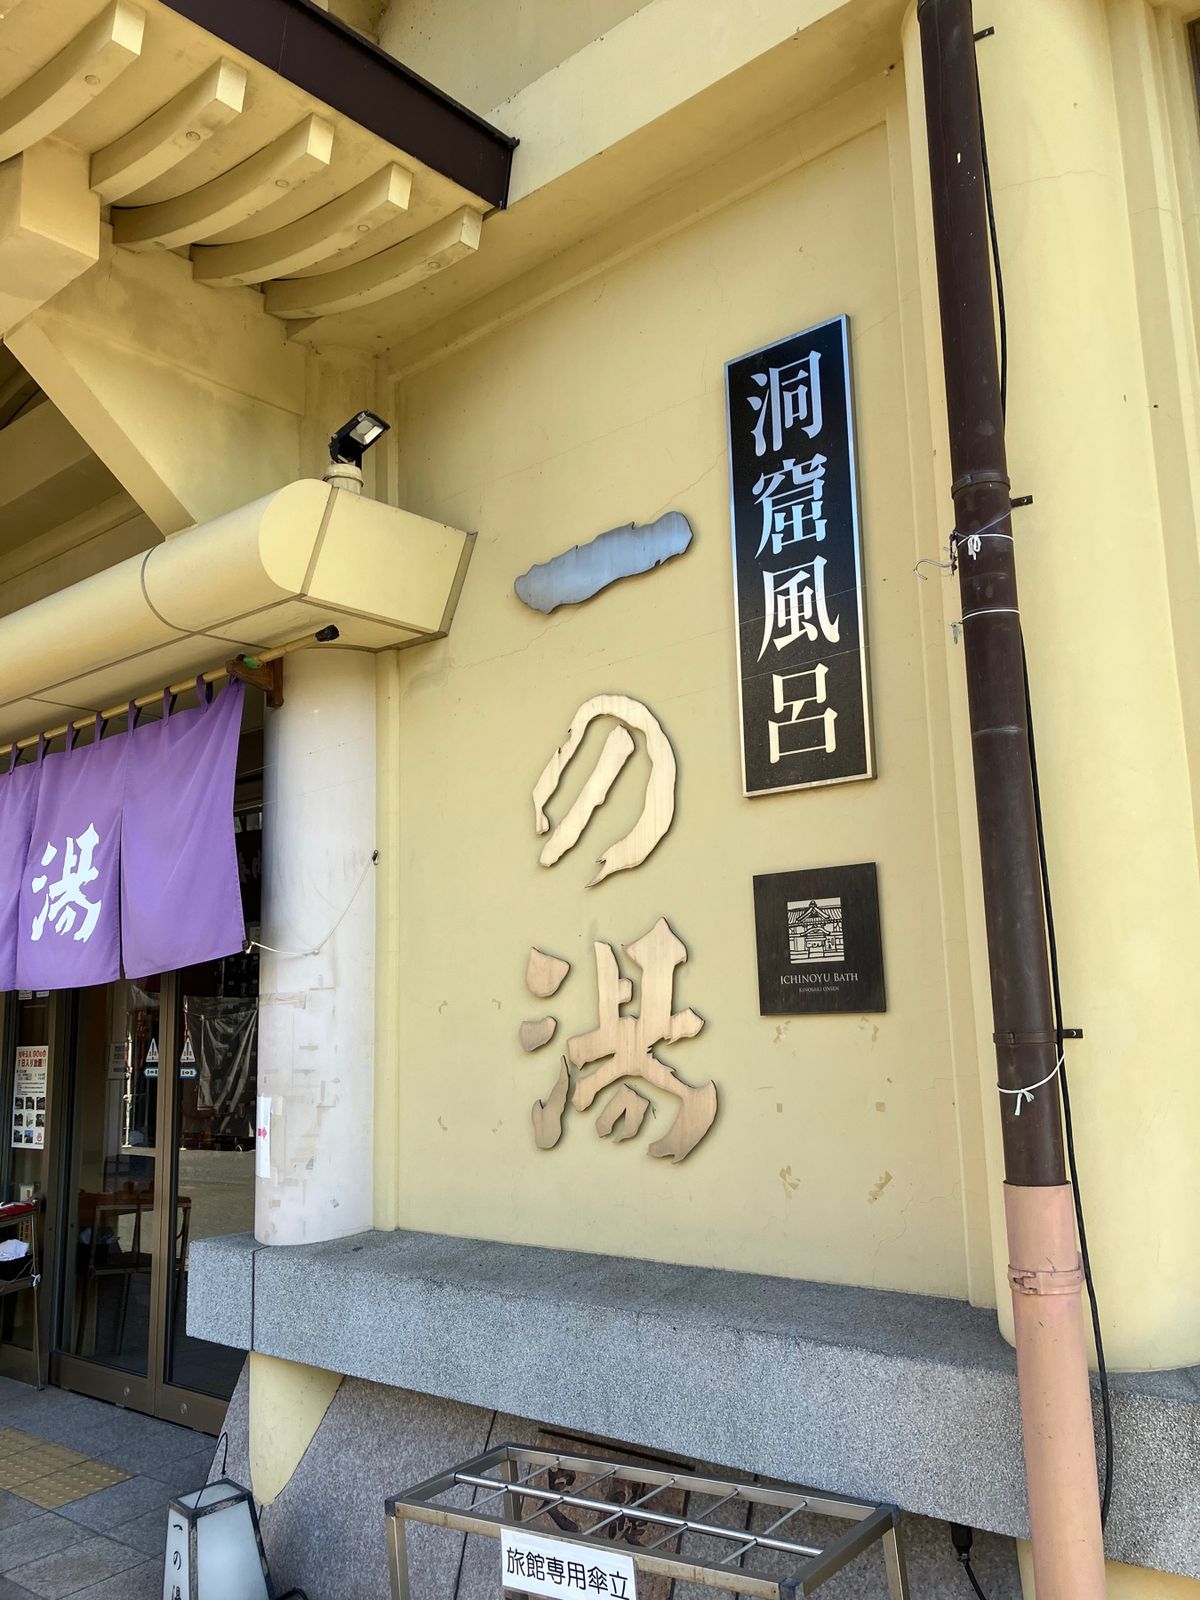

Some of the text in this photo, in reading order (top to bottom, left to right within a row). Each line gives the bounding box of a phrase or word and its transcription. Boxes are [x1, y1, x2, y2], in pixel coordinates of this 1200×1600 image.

[746, 349, 840, 765] 洞窟風呂
[31, 822, 102, 944] 湯
[514, 510, 718, 1164] 一の湯
[780, 972, 858, 985] ICHINOYU BATH
[506, 1547, 631, 1600] 旅館専用傘立
